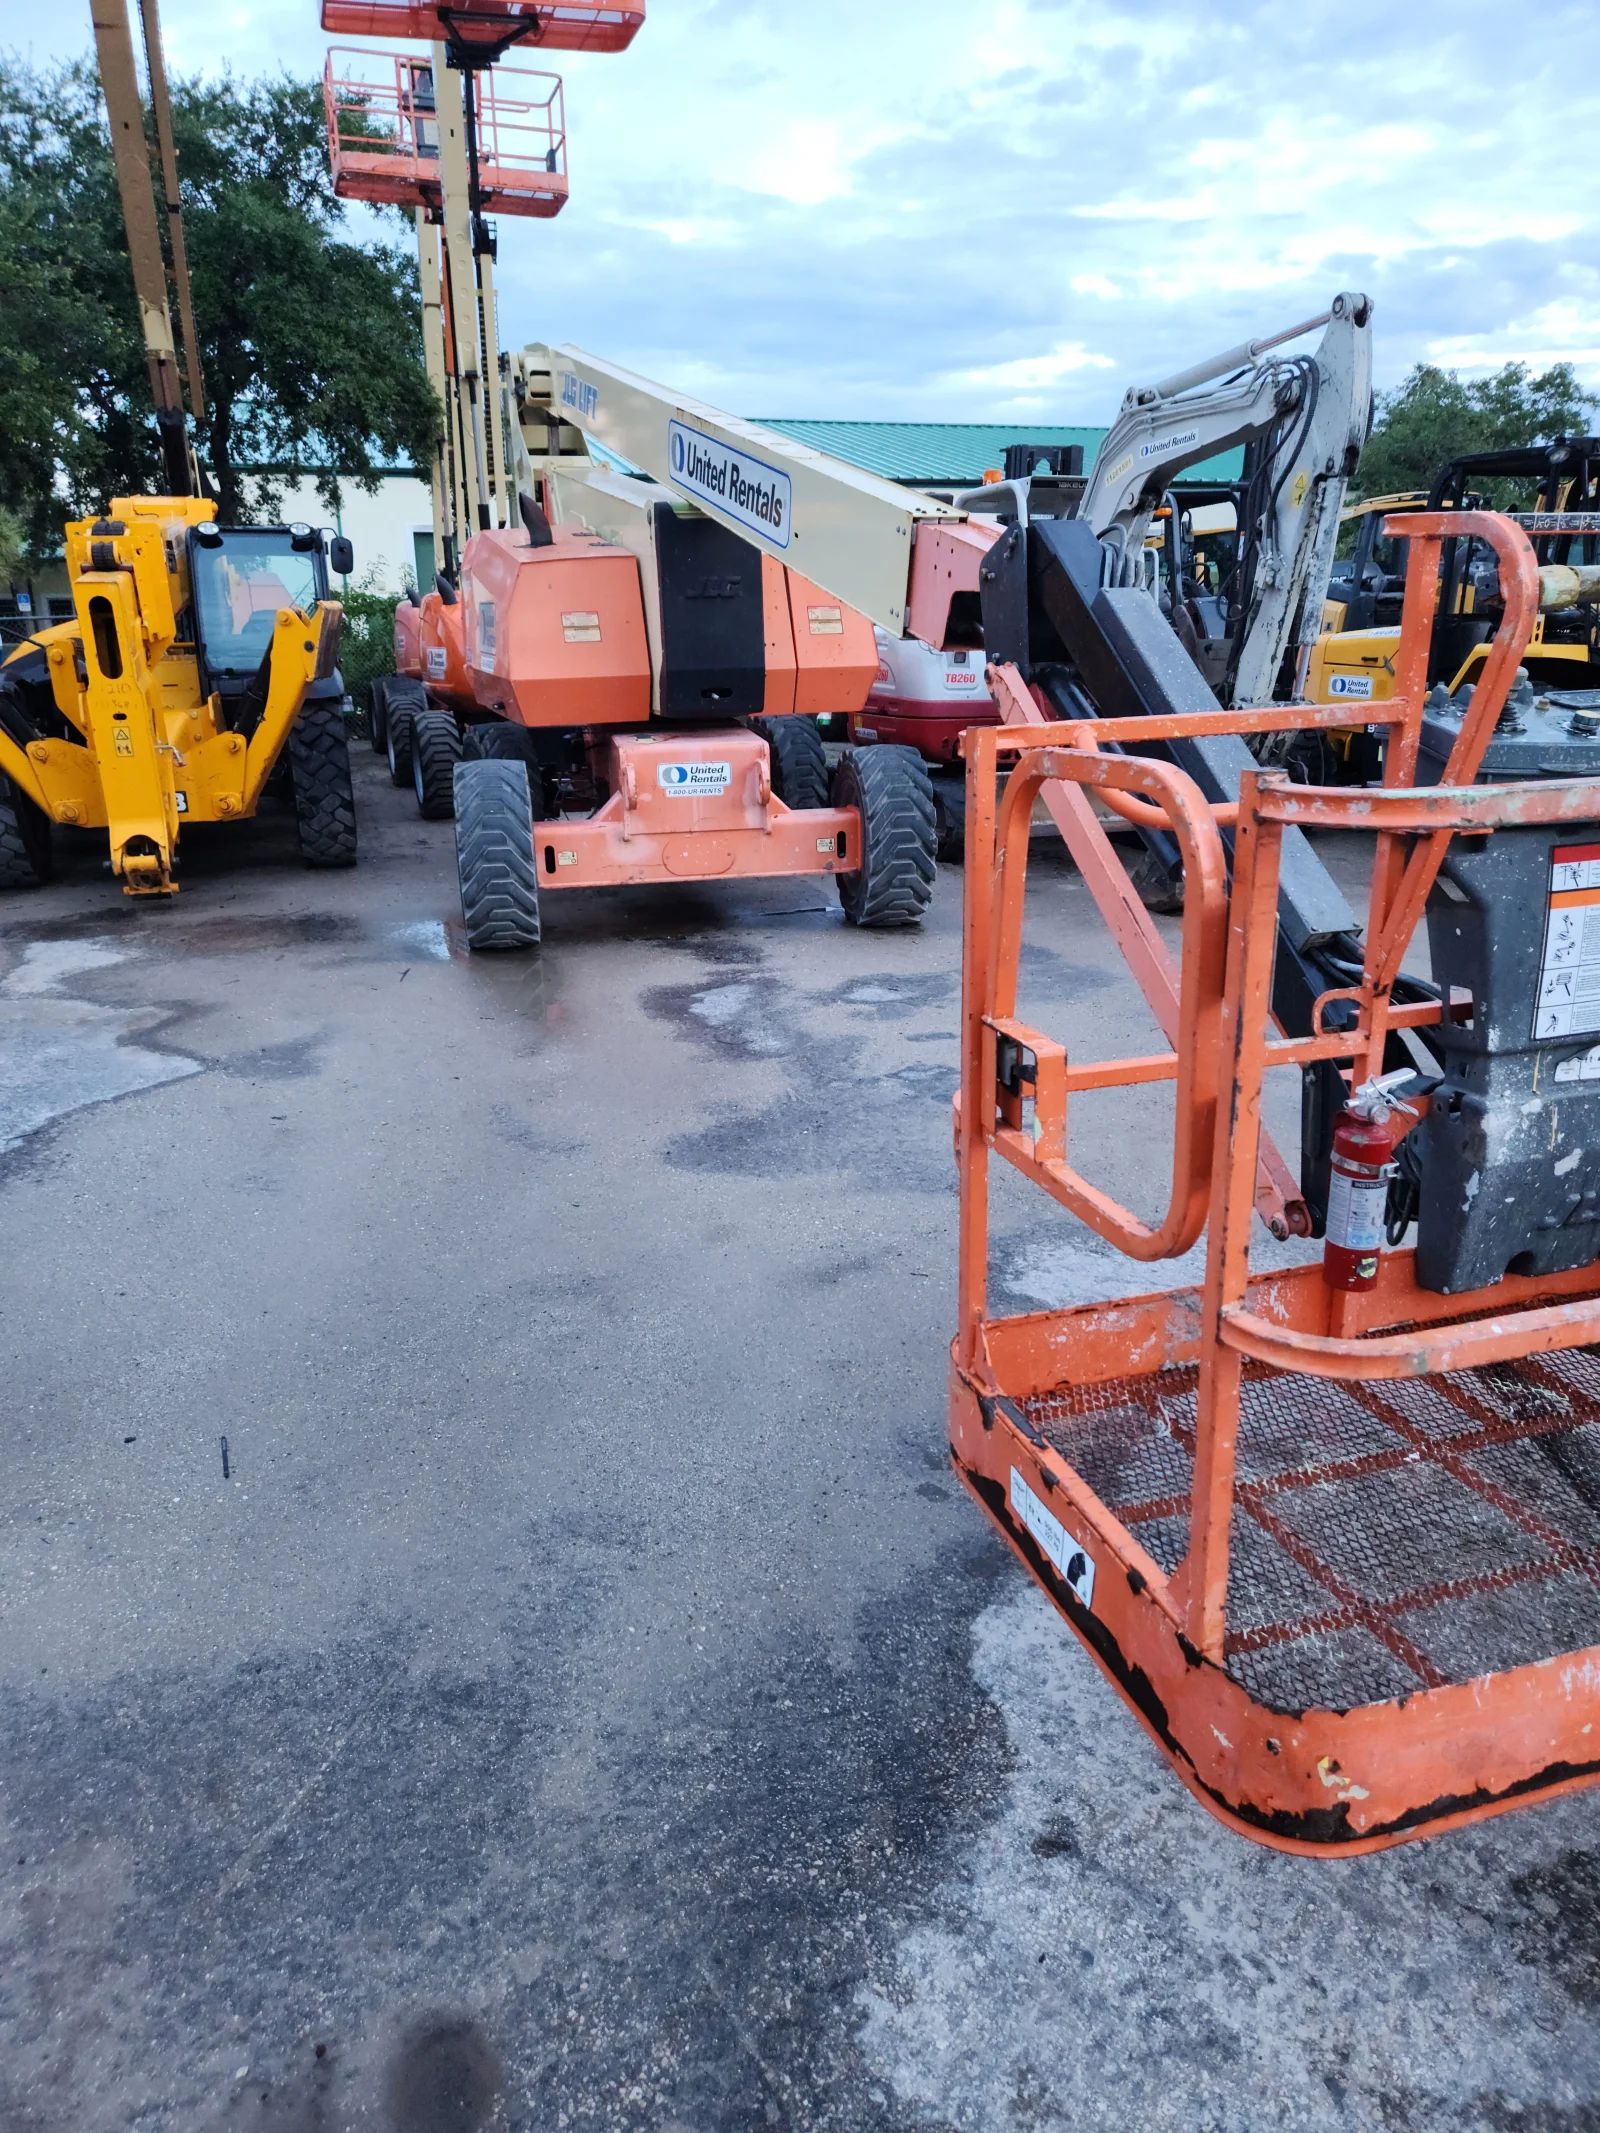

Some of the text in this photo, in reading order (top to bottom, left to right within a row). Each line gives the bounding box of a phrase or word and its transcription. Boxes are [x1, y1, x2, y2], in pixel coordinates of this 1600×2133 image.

[578, 380, 598, 420] LIFT
[1149, 431, 1196, 454] United Rentals
[686, 441, 783, 528] United Rentals
[945, 673, 976, 683] TB260
[1348, 680, 1369, 688] United
[1347, 687, 1369, 695] Rentals
[690, 765, 724, 774] United
[690, 774, 728, 783] Rentals
